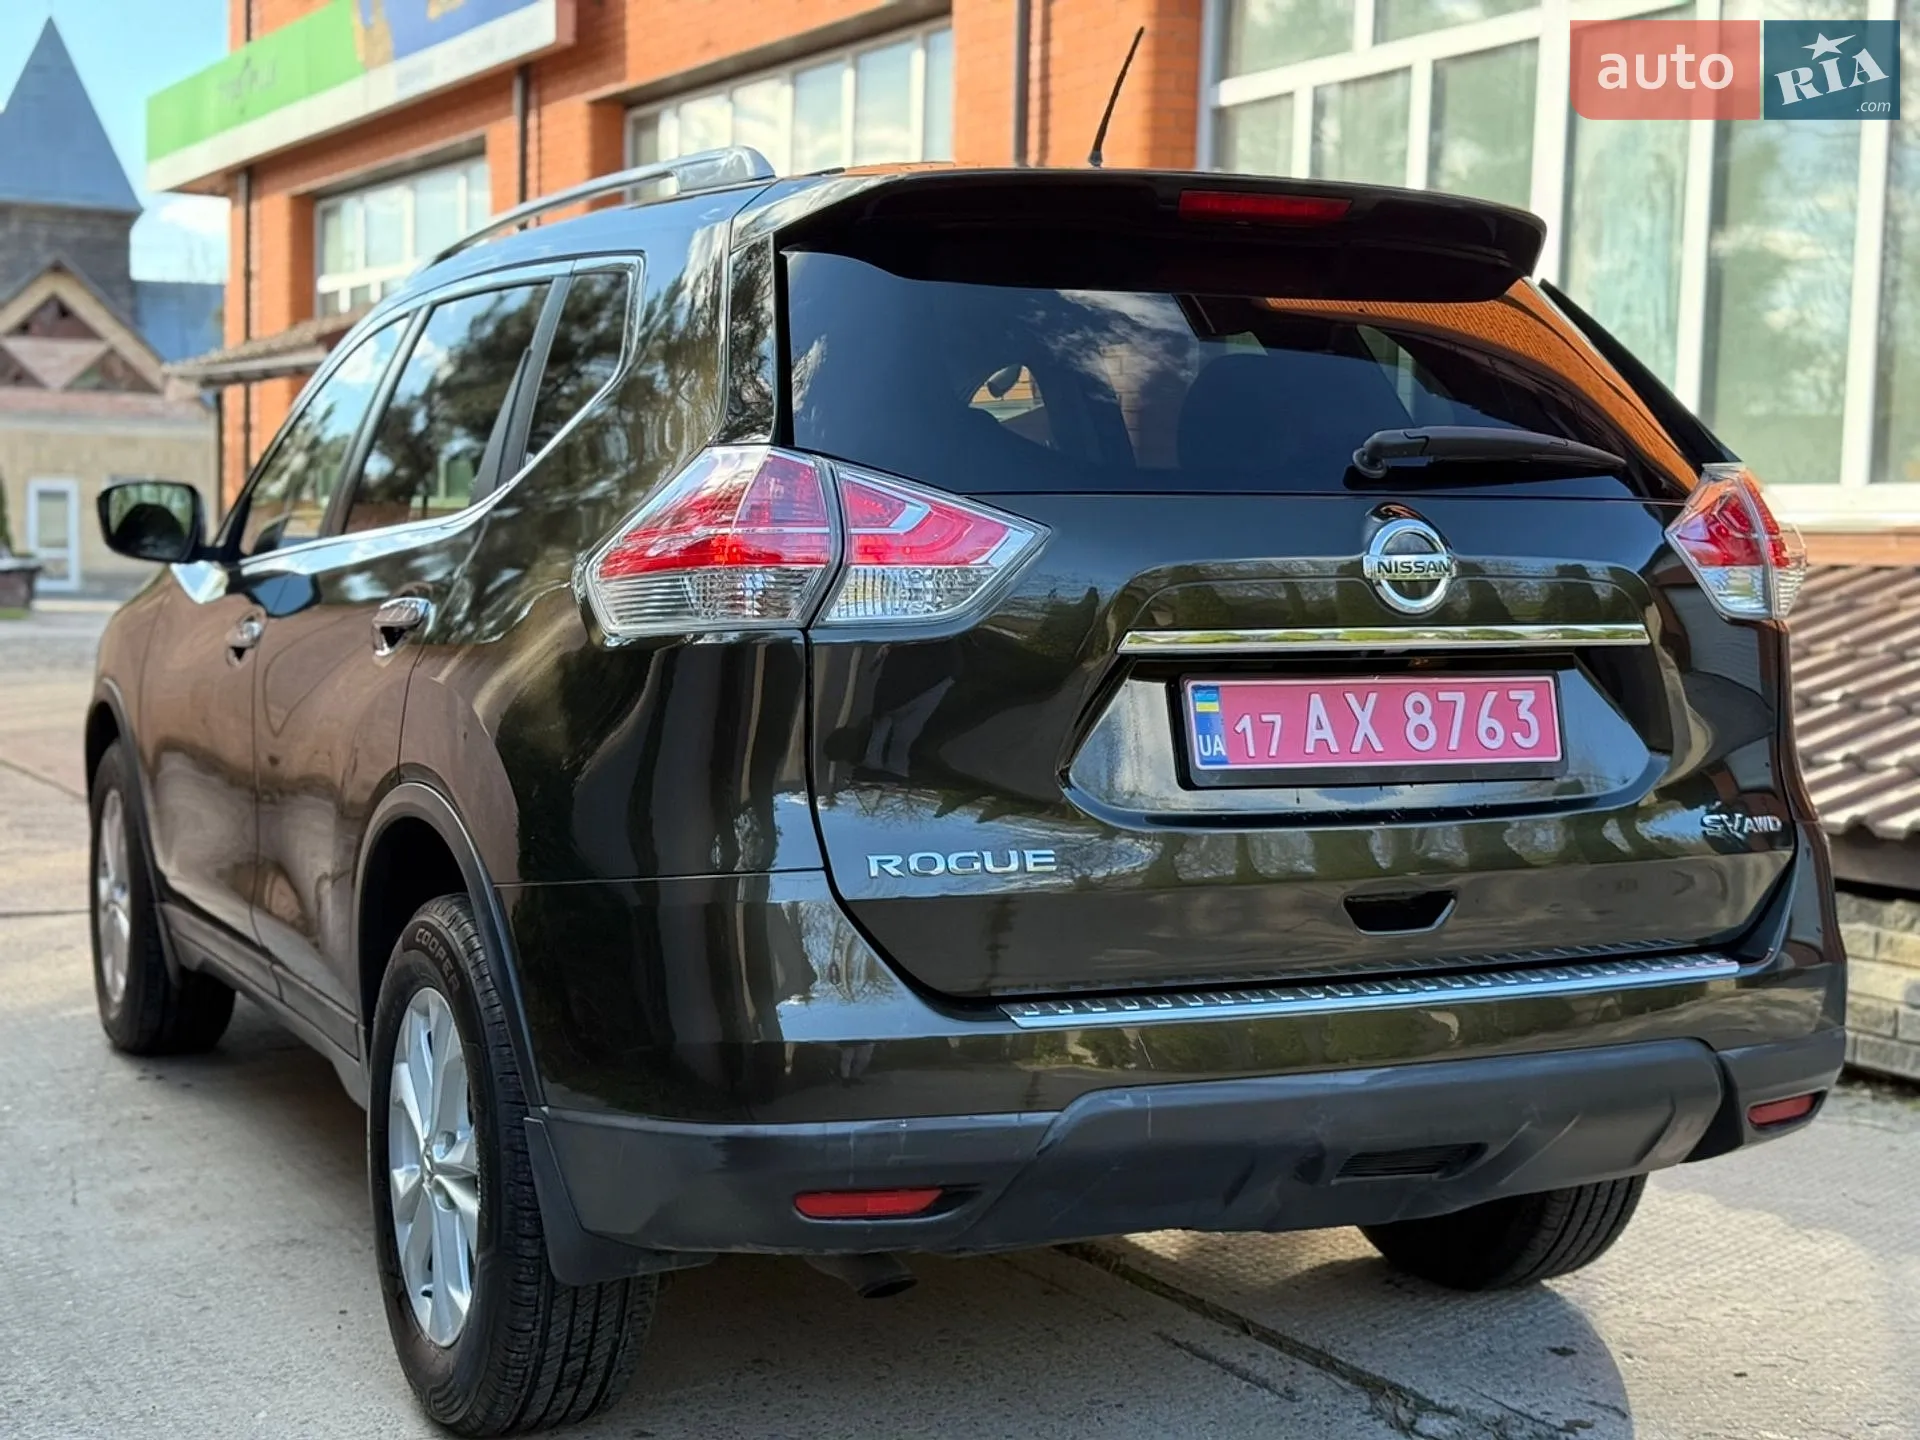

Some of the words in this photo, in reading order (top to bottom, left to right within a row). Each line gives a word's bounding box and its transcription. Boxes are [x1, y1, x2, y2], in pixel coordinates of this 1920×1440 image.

[1377, 560, 1451, 575] NISSAN
[1233, 713, 1283, 758] 17
[1304, 691, 1385, 755] AX
[1403, 689, 1541, 752] 8763
[1199, 734, 1227, 757] UA
[866, 849, 1058, 878] ROGUE
